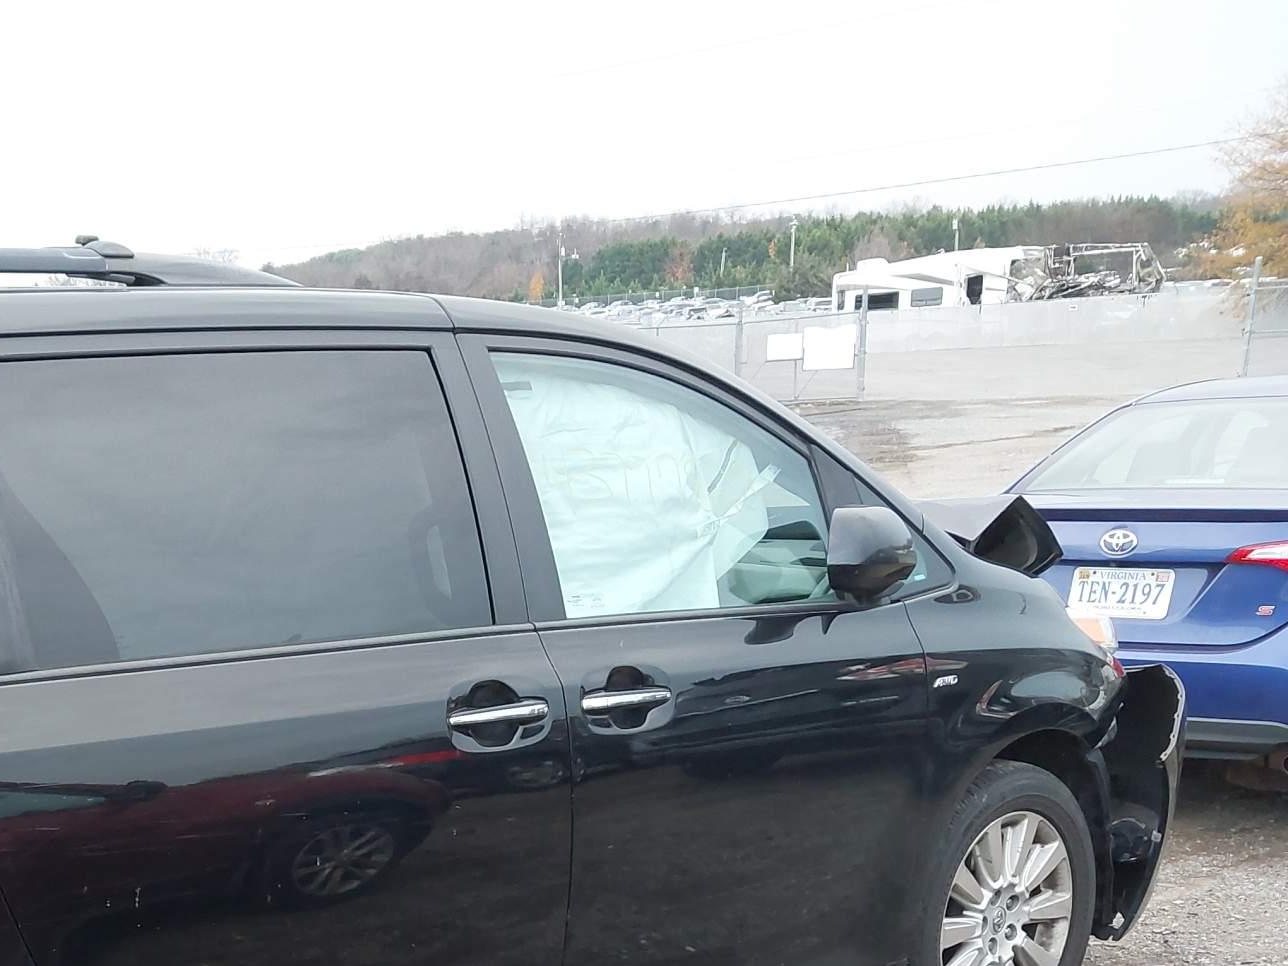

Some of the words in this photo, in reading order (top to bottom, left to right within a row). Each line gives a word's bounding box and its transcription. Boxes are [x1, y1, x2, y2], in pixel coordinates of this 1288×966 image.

[1100, 570, 1147, 581] VIRGINIA
[1078, 580, 1167, 605] TEN-2197
[1255, 605, 1276, 616] S
